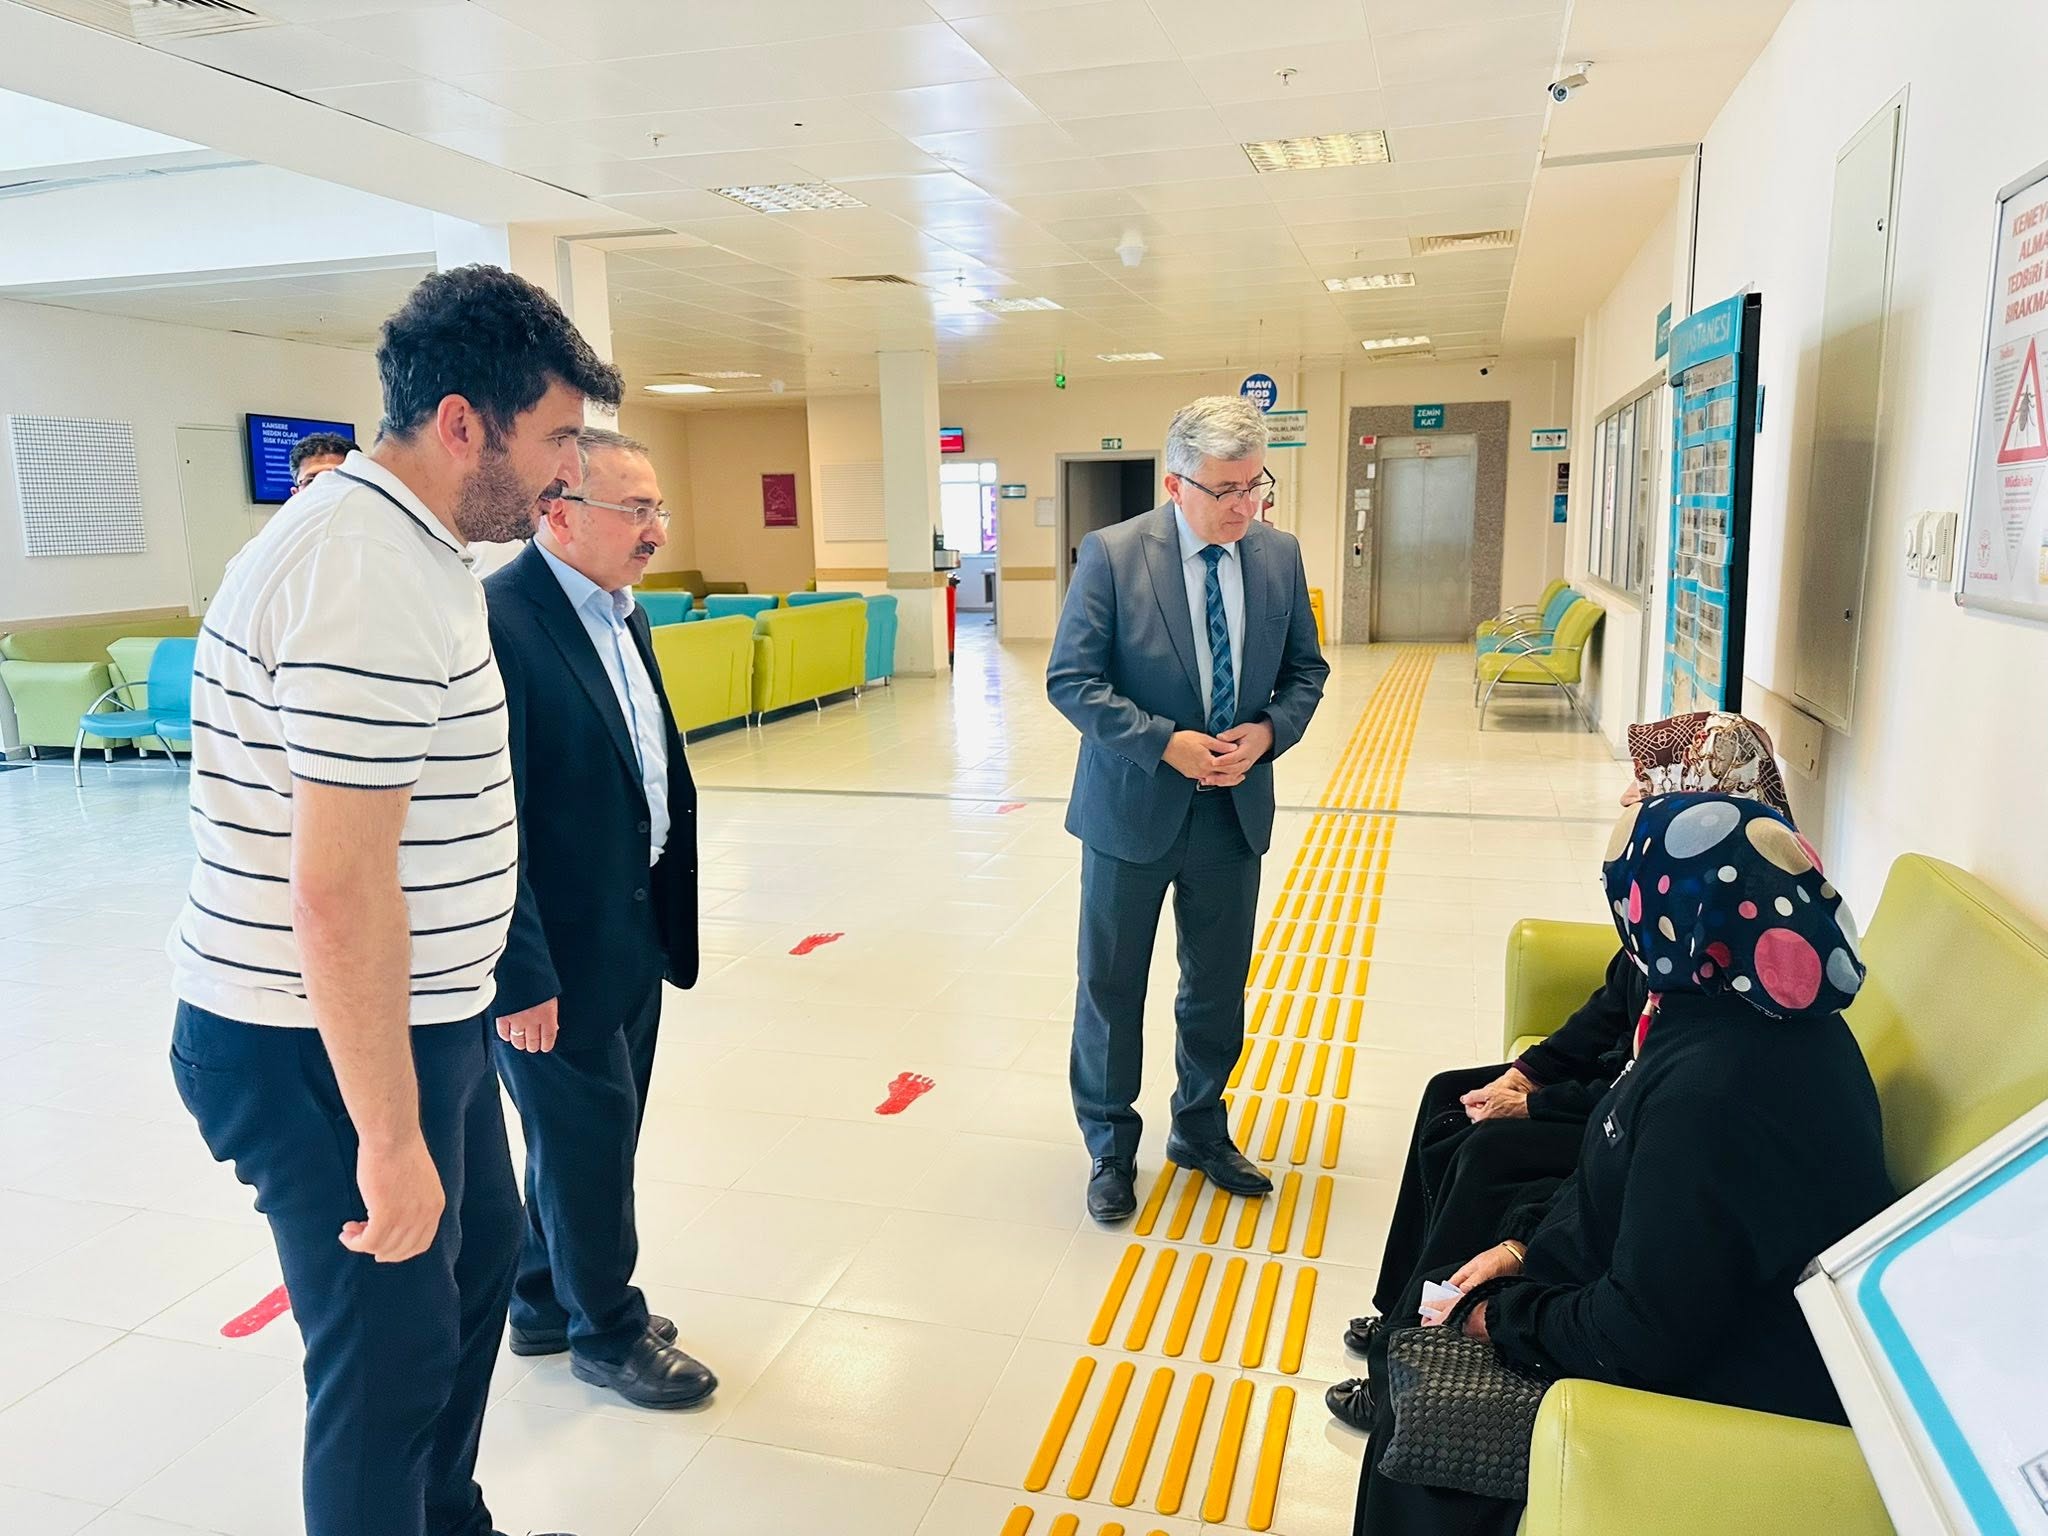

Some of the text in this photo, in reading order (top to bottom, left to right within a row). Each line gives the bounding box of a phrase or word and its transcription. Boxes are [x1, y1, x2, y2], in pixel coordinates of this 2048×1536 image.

[2012, 201, 2048, 238] KENEY
[1248, 389, 1270, 398] KOD
[1417, 408, 1441, 417] ZEMİN
[262, 422, 288, 430] KANSERE
[1421, 418, 1436, 426] KAT
